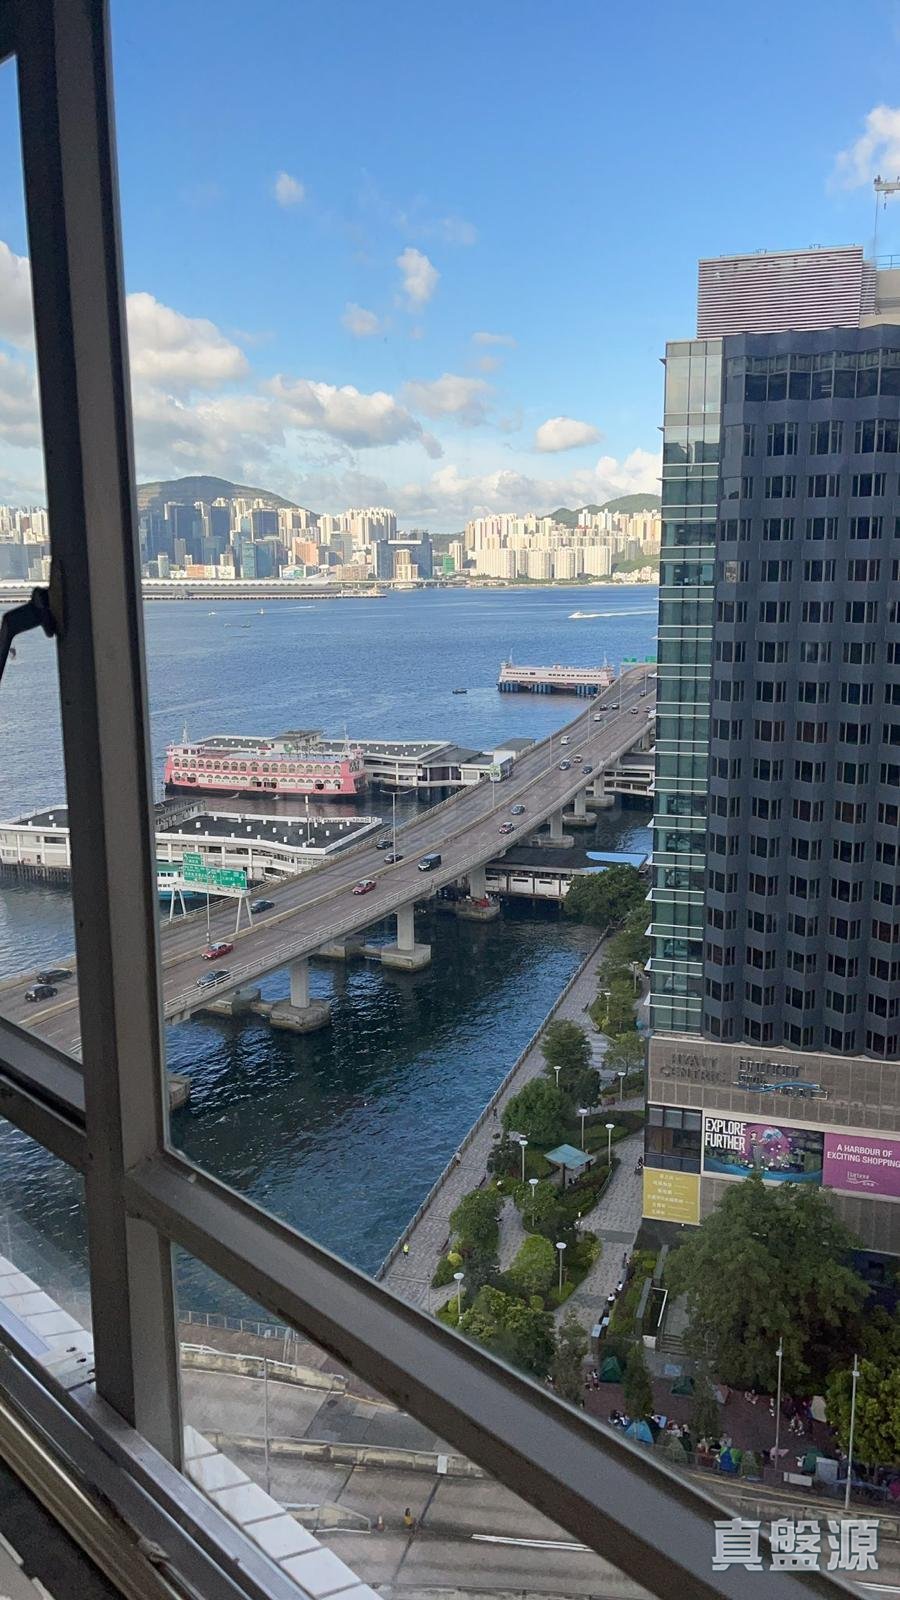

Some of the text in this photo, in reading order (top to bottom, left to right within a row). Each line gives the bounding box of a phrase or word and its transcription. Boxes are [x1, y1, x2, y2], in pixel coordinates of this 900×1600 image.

[705, 1118, 747, 1137] EXPLORE
[704, 1132, 746, 1152] FURTHER
[836, 1143, 893, 1158] A HARBOUR OF
[827, 1151, 900, 1168] EXCITING SHOPPING
